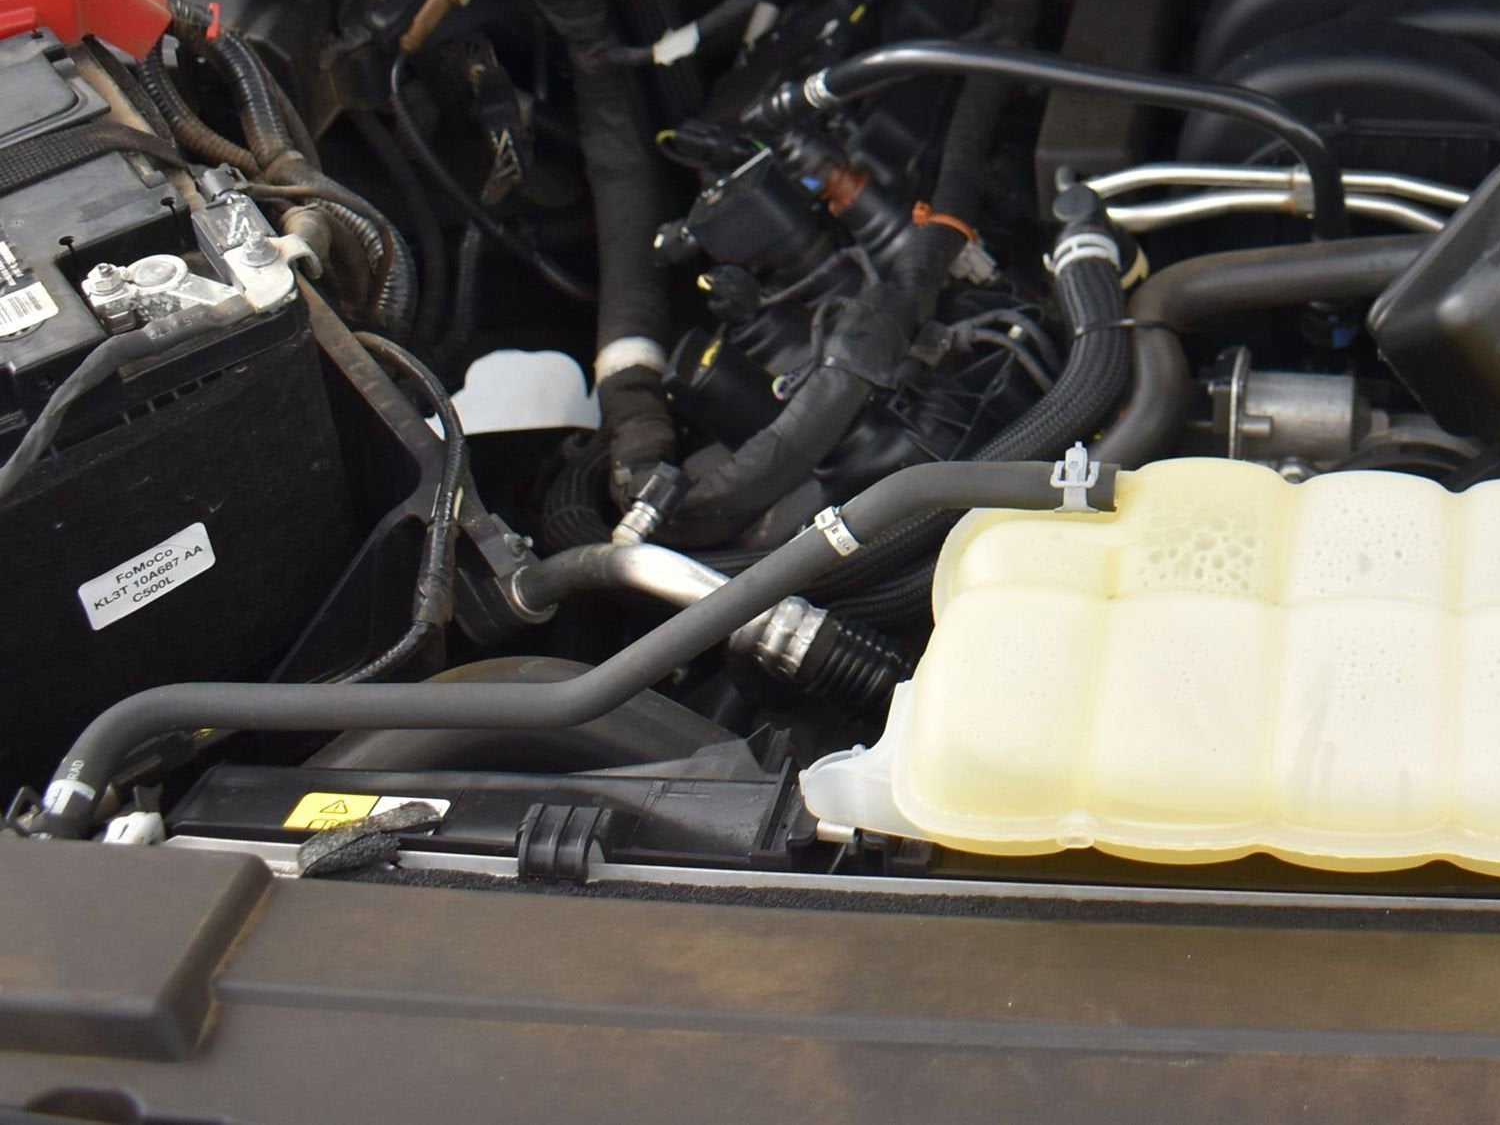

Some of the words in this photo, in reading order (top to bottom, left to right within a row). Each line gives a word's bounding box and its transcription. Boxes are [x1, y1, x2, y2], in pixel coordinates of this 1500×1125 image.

[93, 585, 128, 611] KL3T
[133, 557, 179, 588] 10A687
[184, 545, 203, 561] AA
[115, 549, 173, 583] FoMoCo
[132, 576, 175, 603] C500L
